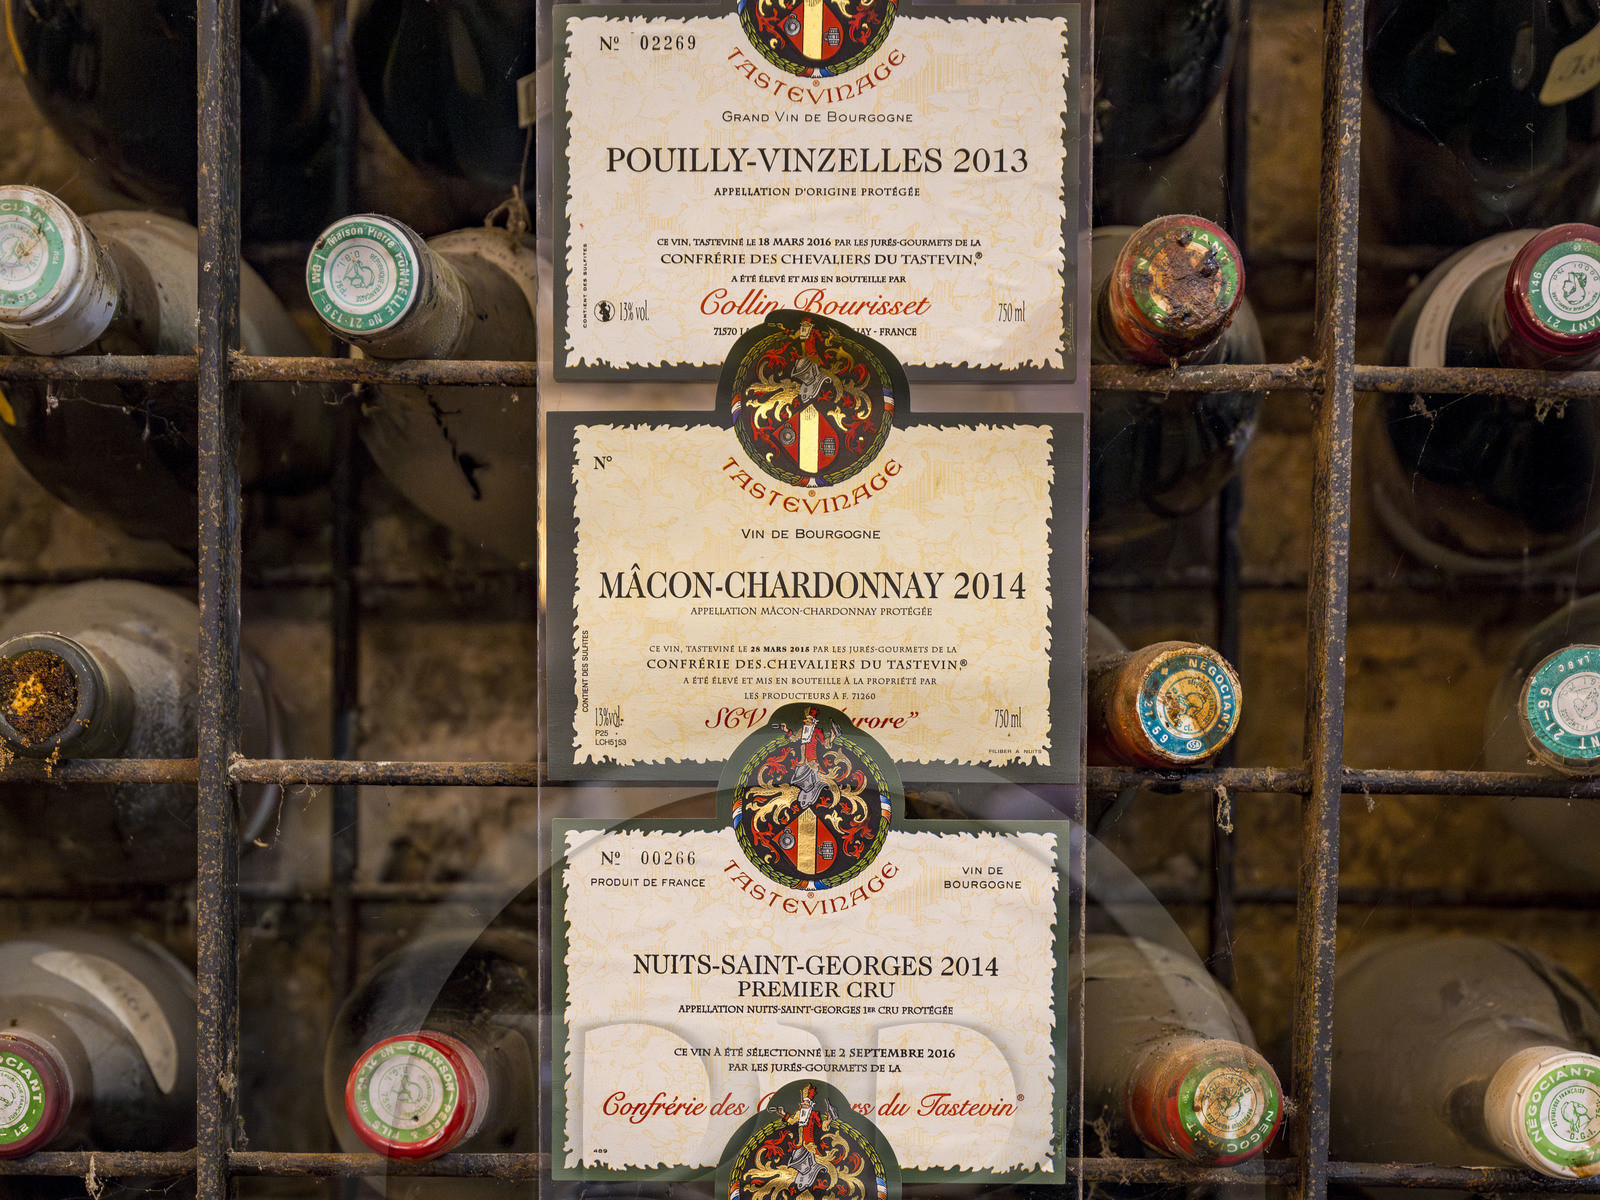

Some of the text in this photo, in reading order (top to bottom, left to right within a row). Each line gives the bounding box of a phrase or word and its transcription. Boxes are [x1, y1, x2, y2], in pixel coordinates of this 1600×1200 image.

[639, 34, 696, 51] 02269
[727, 46, 907, 105] TASTEVINAGE
[606, 146, 1028, 174] POUILLY-VINZELLES 2013
[713, 186, 920, 197] APPELLATION D'ORIGINE PROTÉGÉE
[327, 226, 364, 248] Maison
[367, 227, 396, 250] Pierre
[699, 287, 932, 316] Collin Bourisset
[998, 301, 1026, 323] 750 ml
[721, 456, 904, 515] TASTEVINAGE
[598, 562, 1027, 600] MÂCON-CHARDONNAY 2014
[690, 605, 933, 617] APPELLATION MÂCON-CHARDONNAY PROTÉGÉE
[744, 691, 876, 701] LES PRODUCTEURS À F. 71260
[994, 706, 1022, 729] 750 ml
[640, 850, 696, 866] 00266
[961, 866, 1004, 876] VIN DE
[590, 877, 706, 888] PRODUIT DE FRANCE
[723, 859, 900, 916] TASTEVINAGE
[943, 879, 1022, 890] BOURGOGNE
[632, 953, 999, 977] NUITS-SAINT-GEORGES 2014
[737, 980, 896, 999] PREMIER CRU
[677, 1004, 745, 1014] APPELLATION
[746, 1004, 861, 1015] NUITS-SAINT-GEORGES
[877, 1005, 900, 1015] CRU
[901, 1004, 954, 1016] PROTÉGÉE
[602, 1090, 708, 1125] Confrérie
[709, 1091, 752, 1117] des
[877, 1091, 912, 1117] du
